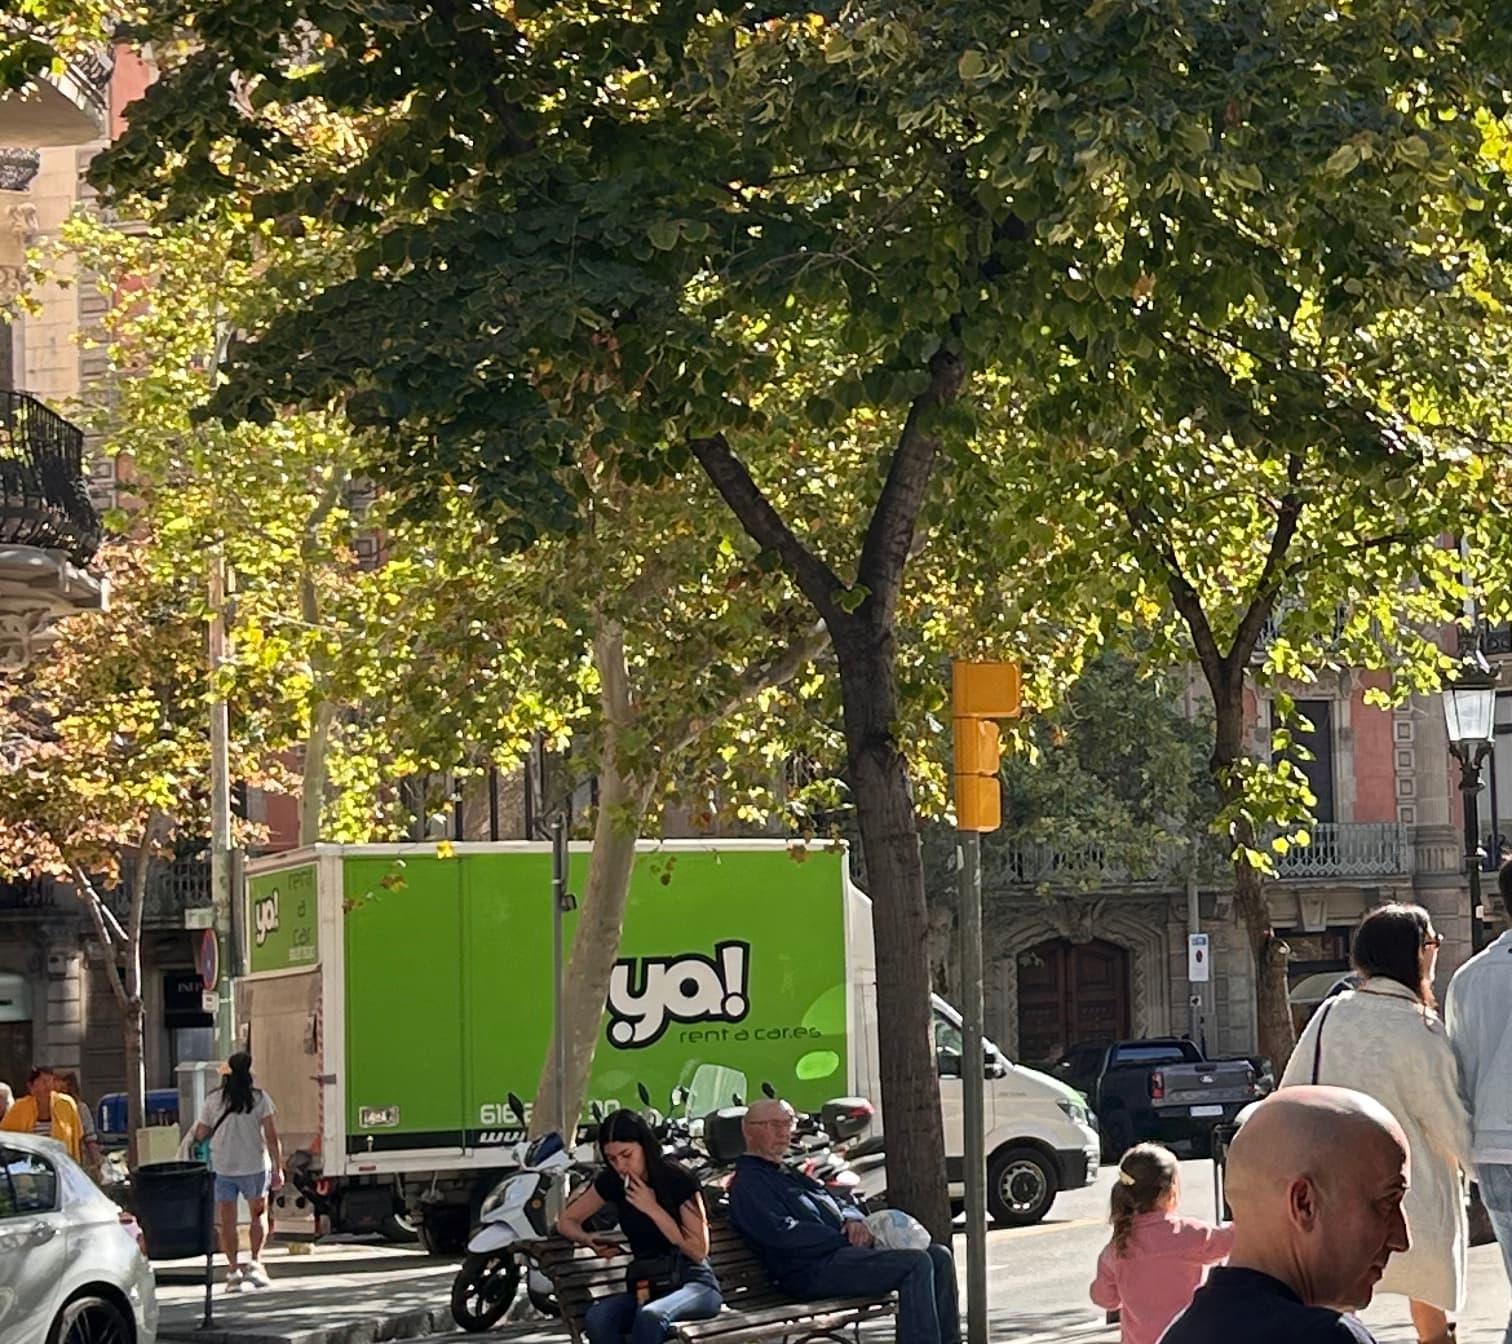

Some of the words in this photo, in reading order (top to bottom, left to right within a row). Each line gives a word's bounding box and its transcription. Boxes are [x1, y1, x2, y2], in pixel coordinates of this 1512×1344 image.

[255, 887, 280, 947] ya!
[606, 941, 751, 1049] ya!
[680, 1029, 729, 1044] rent
[734, 1029, 750, 1041] a
[755, 1026, 822, 1041] car.es
